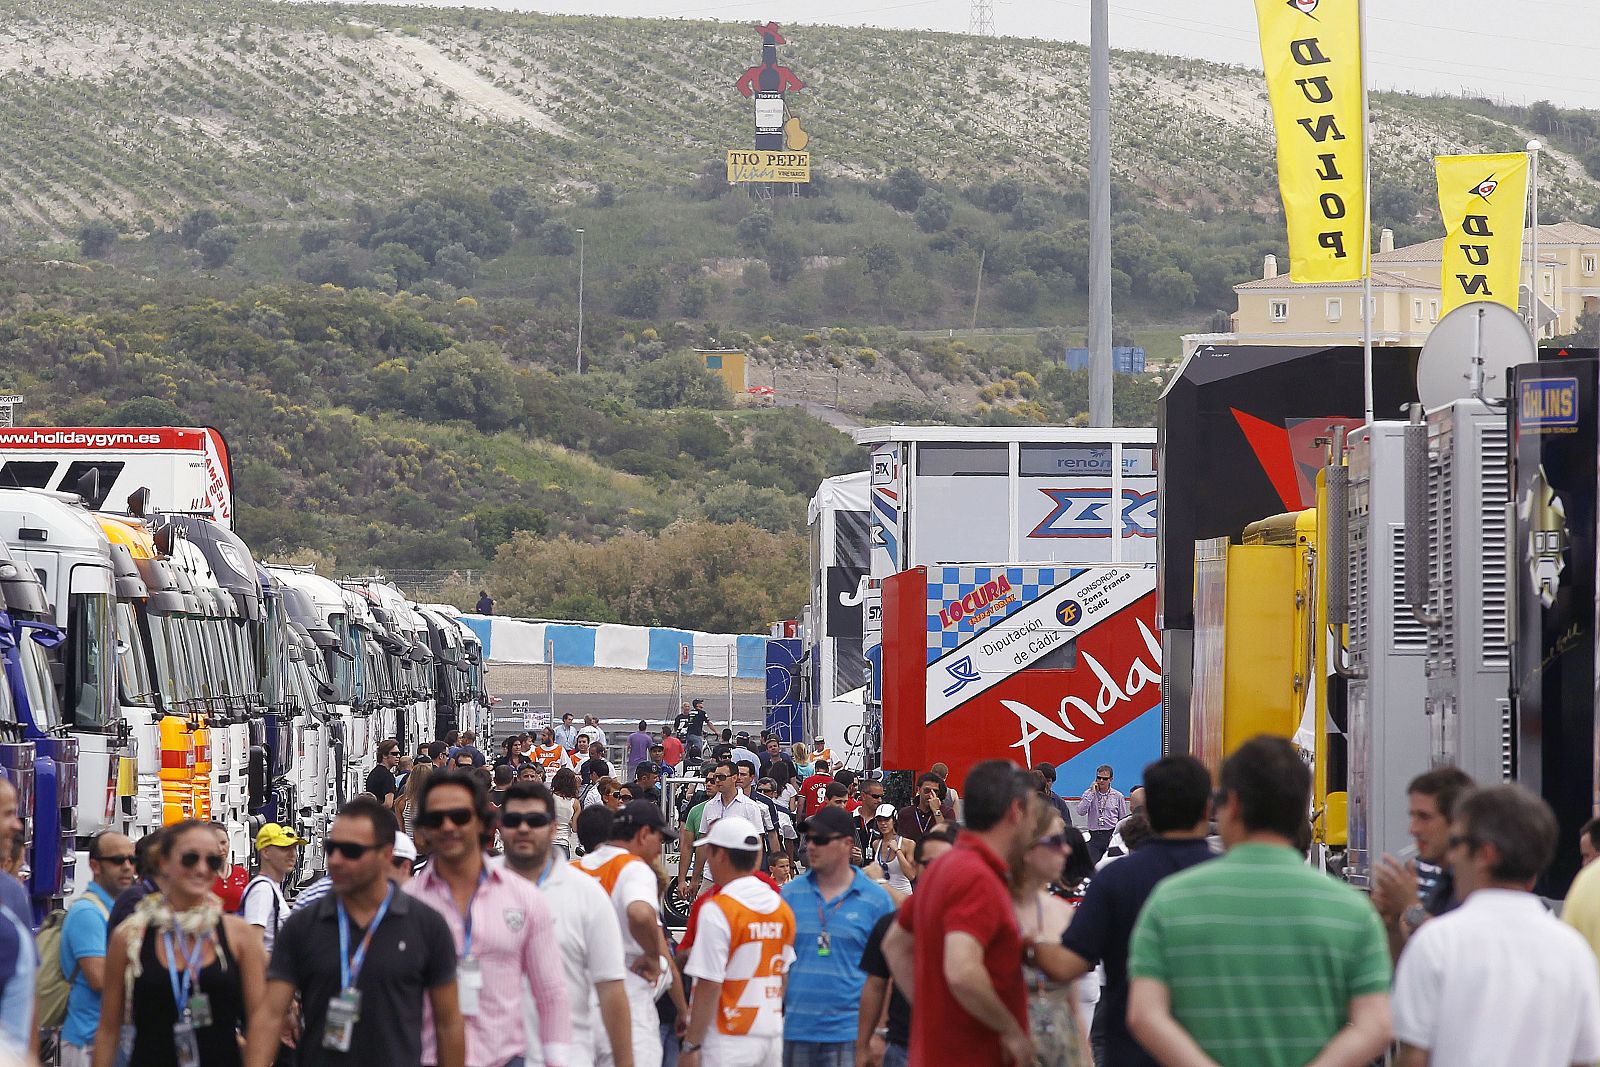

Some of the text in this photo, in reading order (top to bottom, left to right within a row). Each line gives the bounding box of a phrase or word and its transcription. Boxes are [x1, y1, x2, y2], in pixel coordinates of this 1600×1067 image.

[730, 153, 808, 167] TIO PEPE
[1522, 384, 1573, 418] ÖHLINS
[1076, 568, 1118, 598] CONSORCIO
[1082, 572, 1131, 607] Zona Franca
[938, 574, 1012, 629] LOCURA
[982, 617, 1044, 656] Diputación
[1013, 630, 1061, 665] de Cádiz
[816, 787, 827, 804] 9
